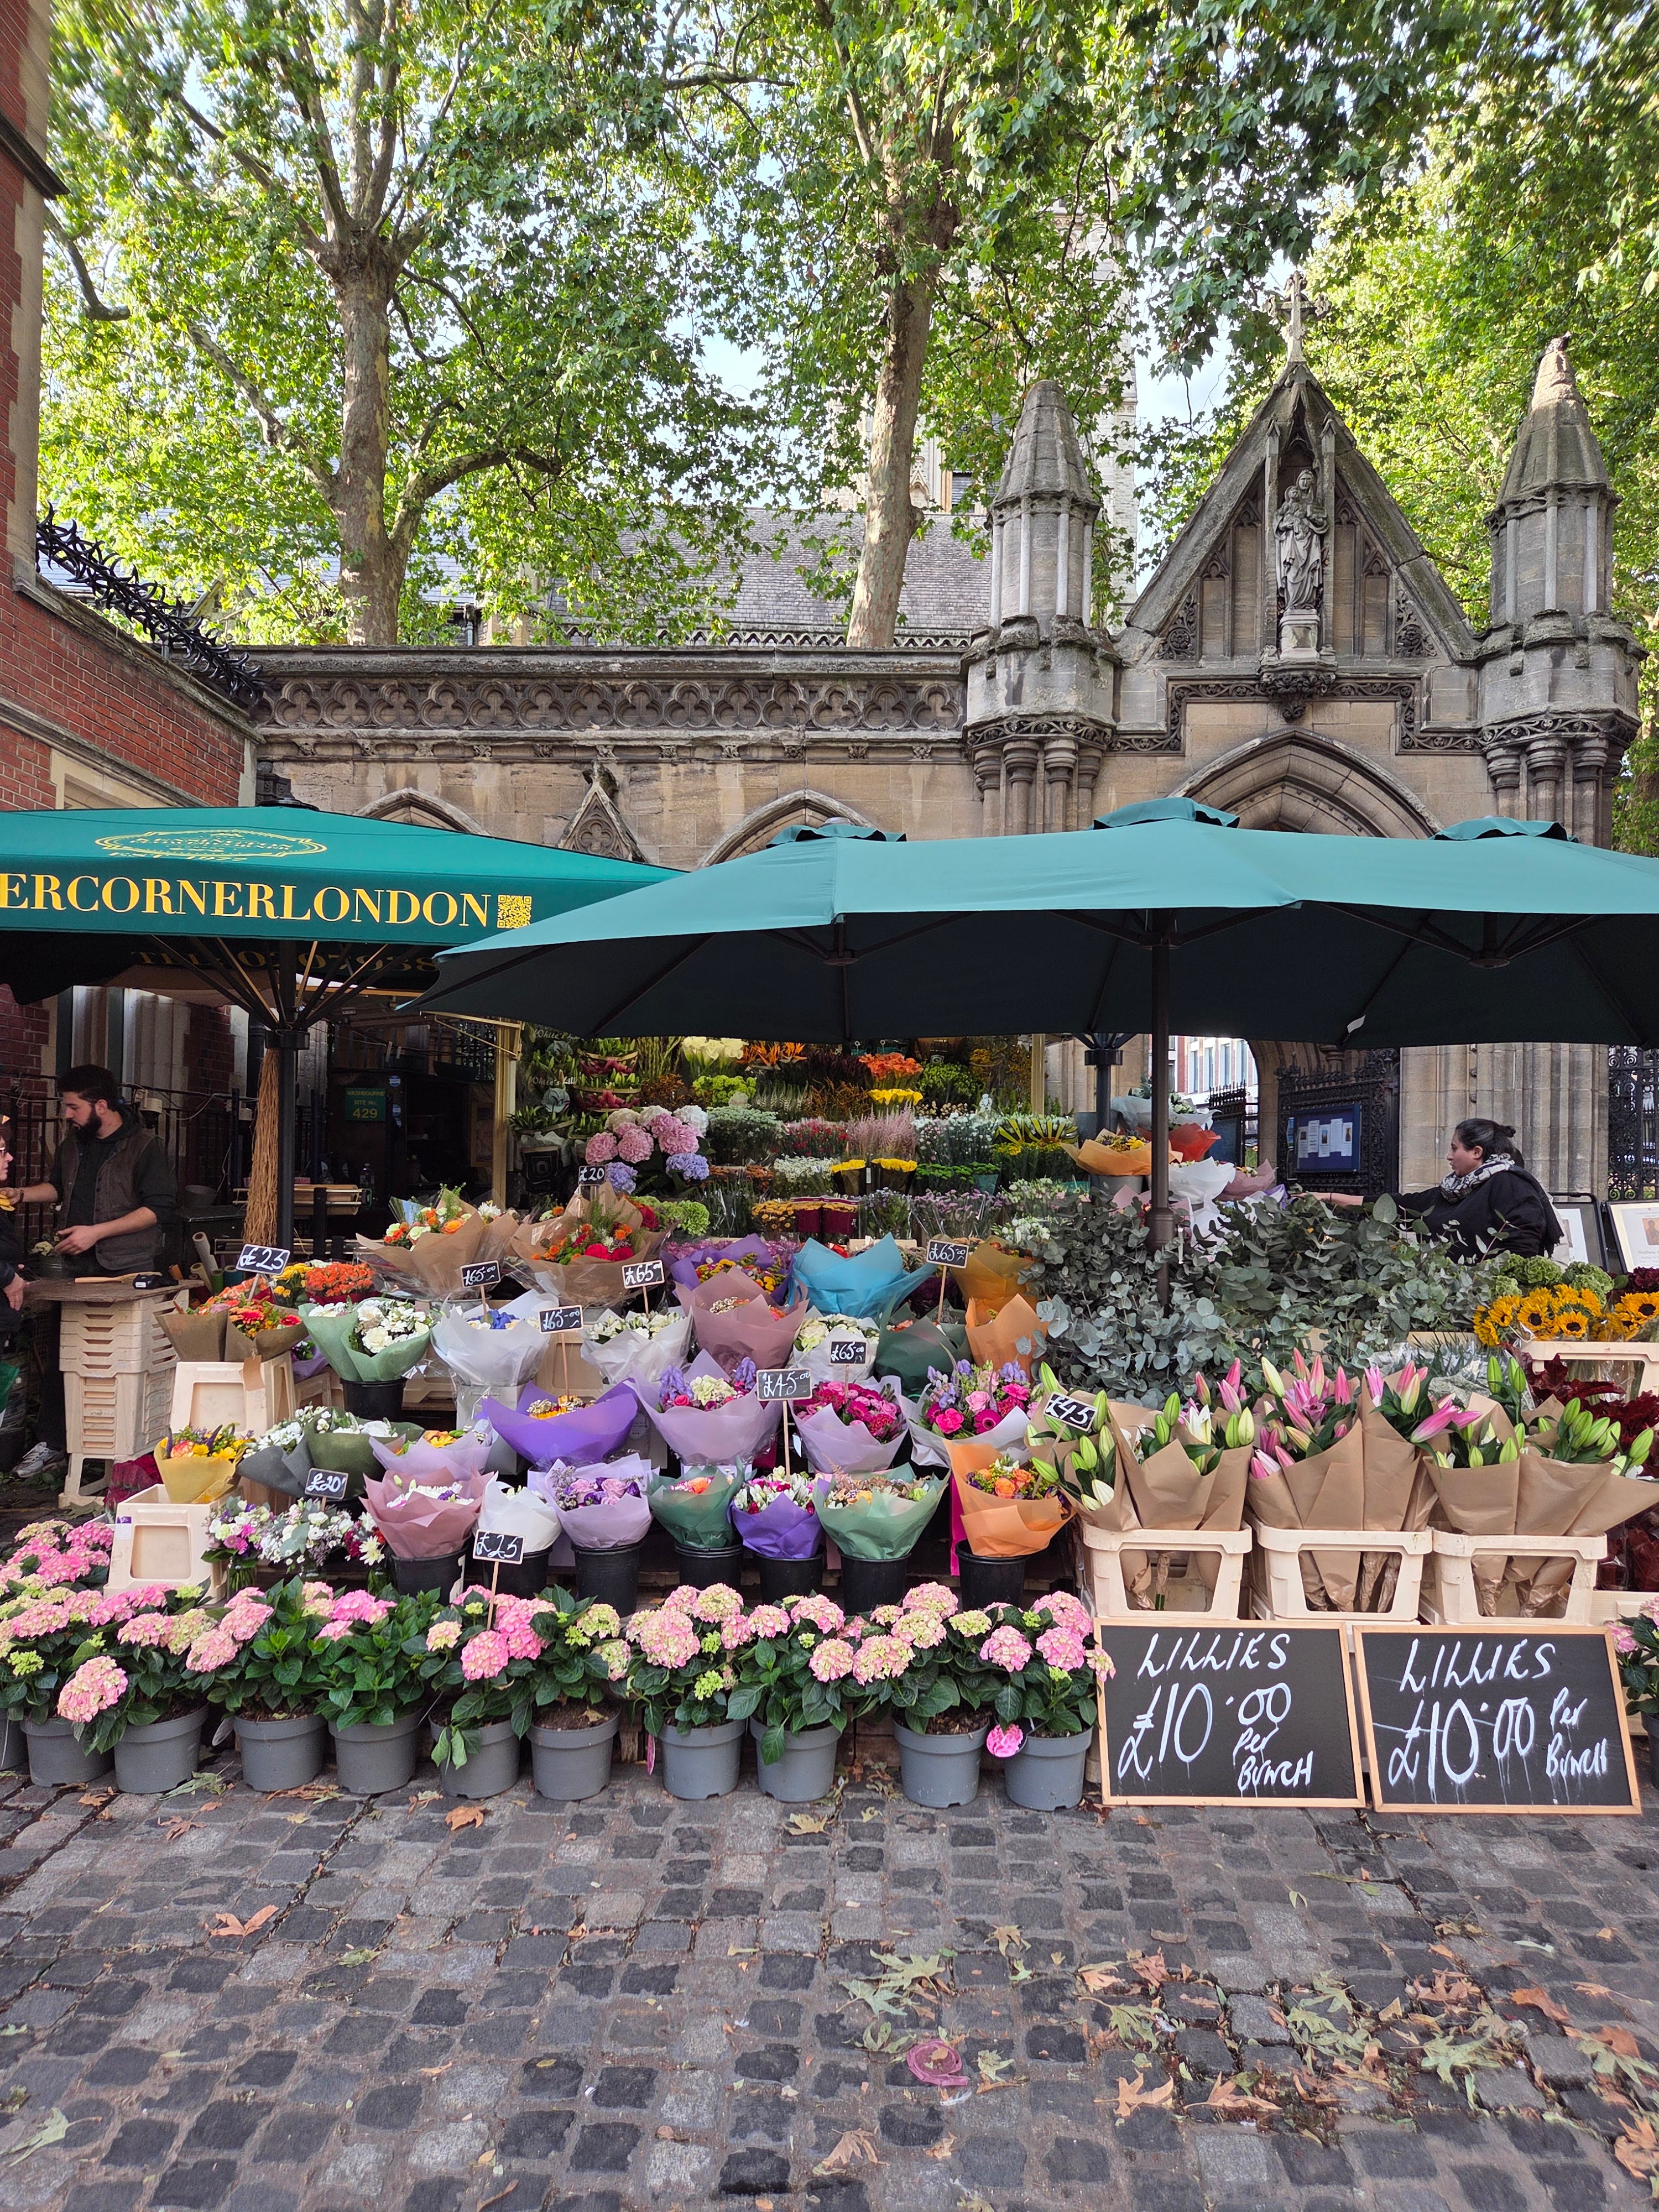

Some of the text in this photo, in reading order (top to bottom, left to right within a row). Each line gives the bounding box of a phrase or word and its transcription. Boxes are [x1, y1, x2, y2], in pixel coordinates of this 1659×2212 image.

[353, 1108, 378, 1119] 429
[579, 1167, 605, 1182] £20
[240, 1247, 287, 1270] £25
[1045, 1396, 1097, 1425] £45
[476, 1531, 524, 1559] £25
[1136, 1631, 1290, 1678] LILLIES
[1399, 1638, 1556, 1692] LILLIES
